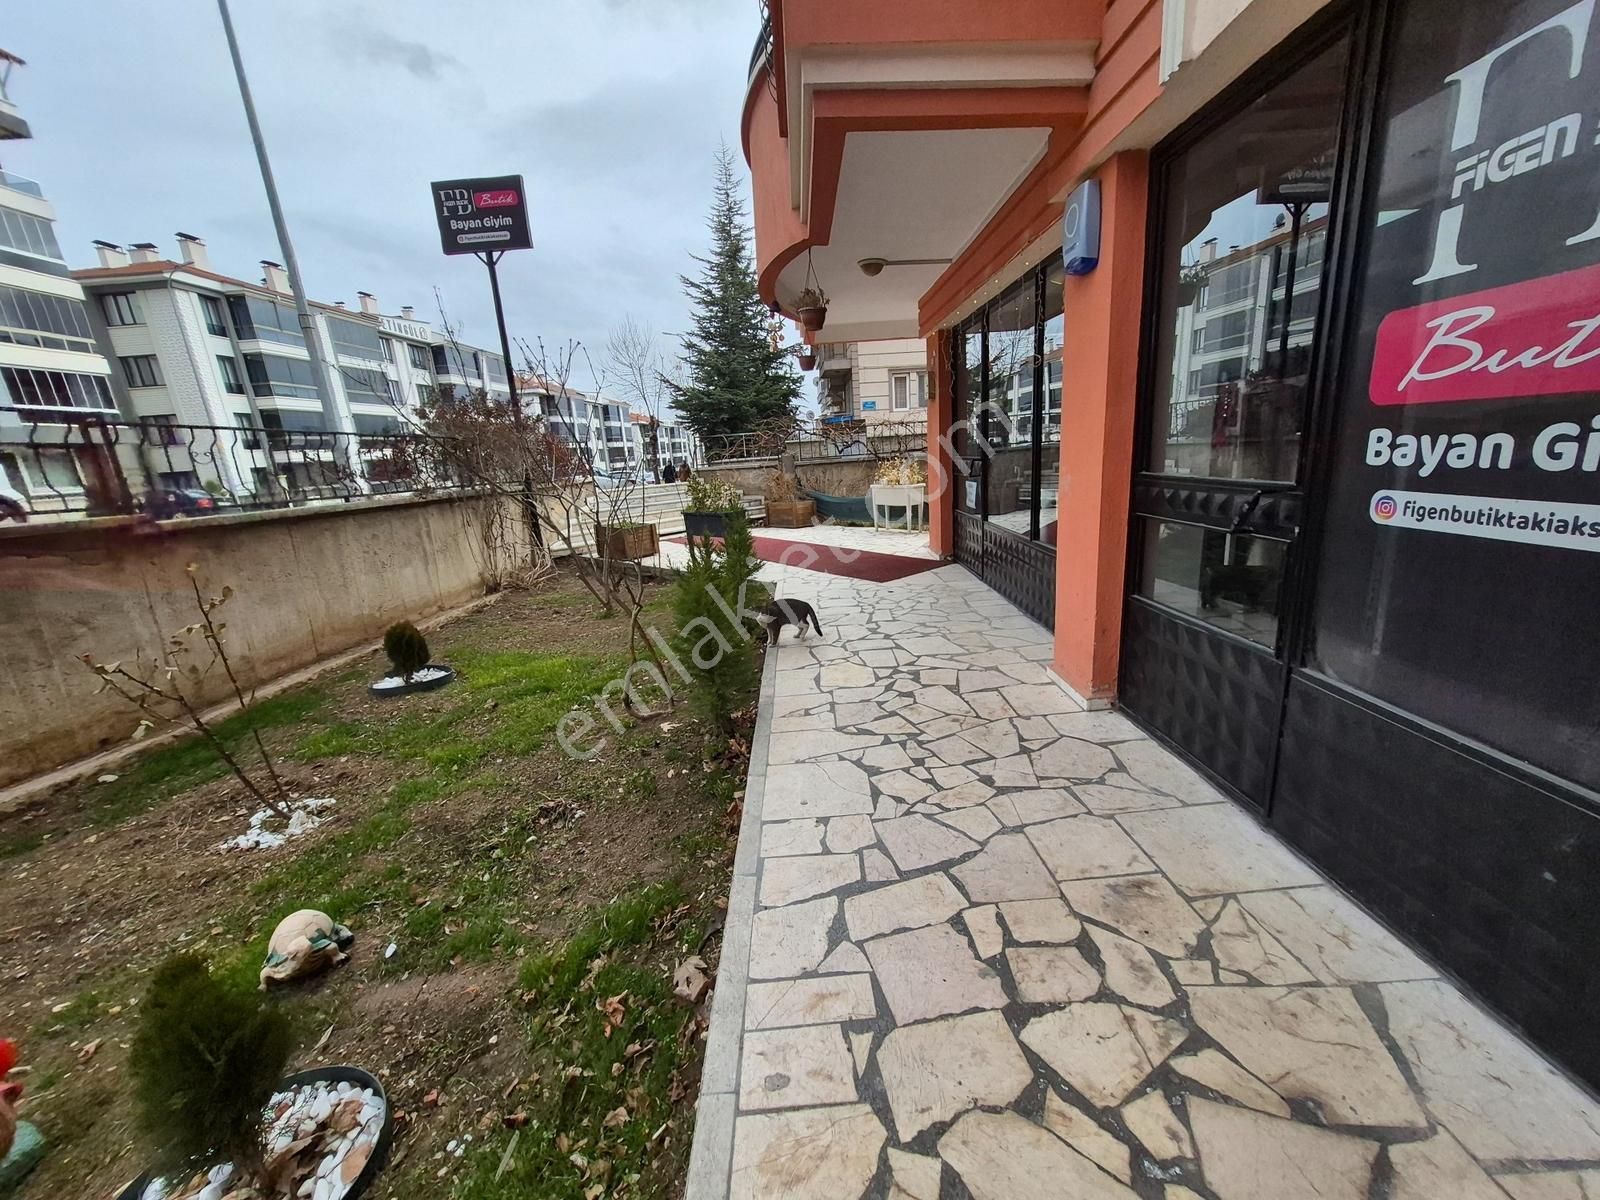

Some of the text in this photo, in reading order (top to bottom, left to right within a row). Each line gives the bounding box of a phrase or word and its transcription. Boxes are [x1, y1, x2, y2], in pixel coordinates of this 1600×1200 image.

[480, 193, 513, 206] Butik
[450, 215, 513, 231] Bayan Giyim
[1397, 305, 1600, 392] But
[1365, 414, 1600, 478] Bayan Gi
[1402, 500, 1600, 538] figenbutiktakiaks
